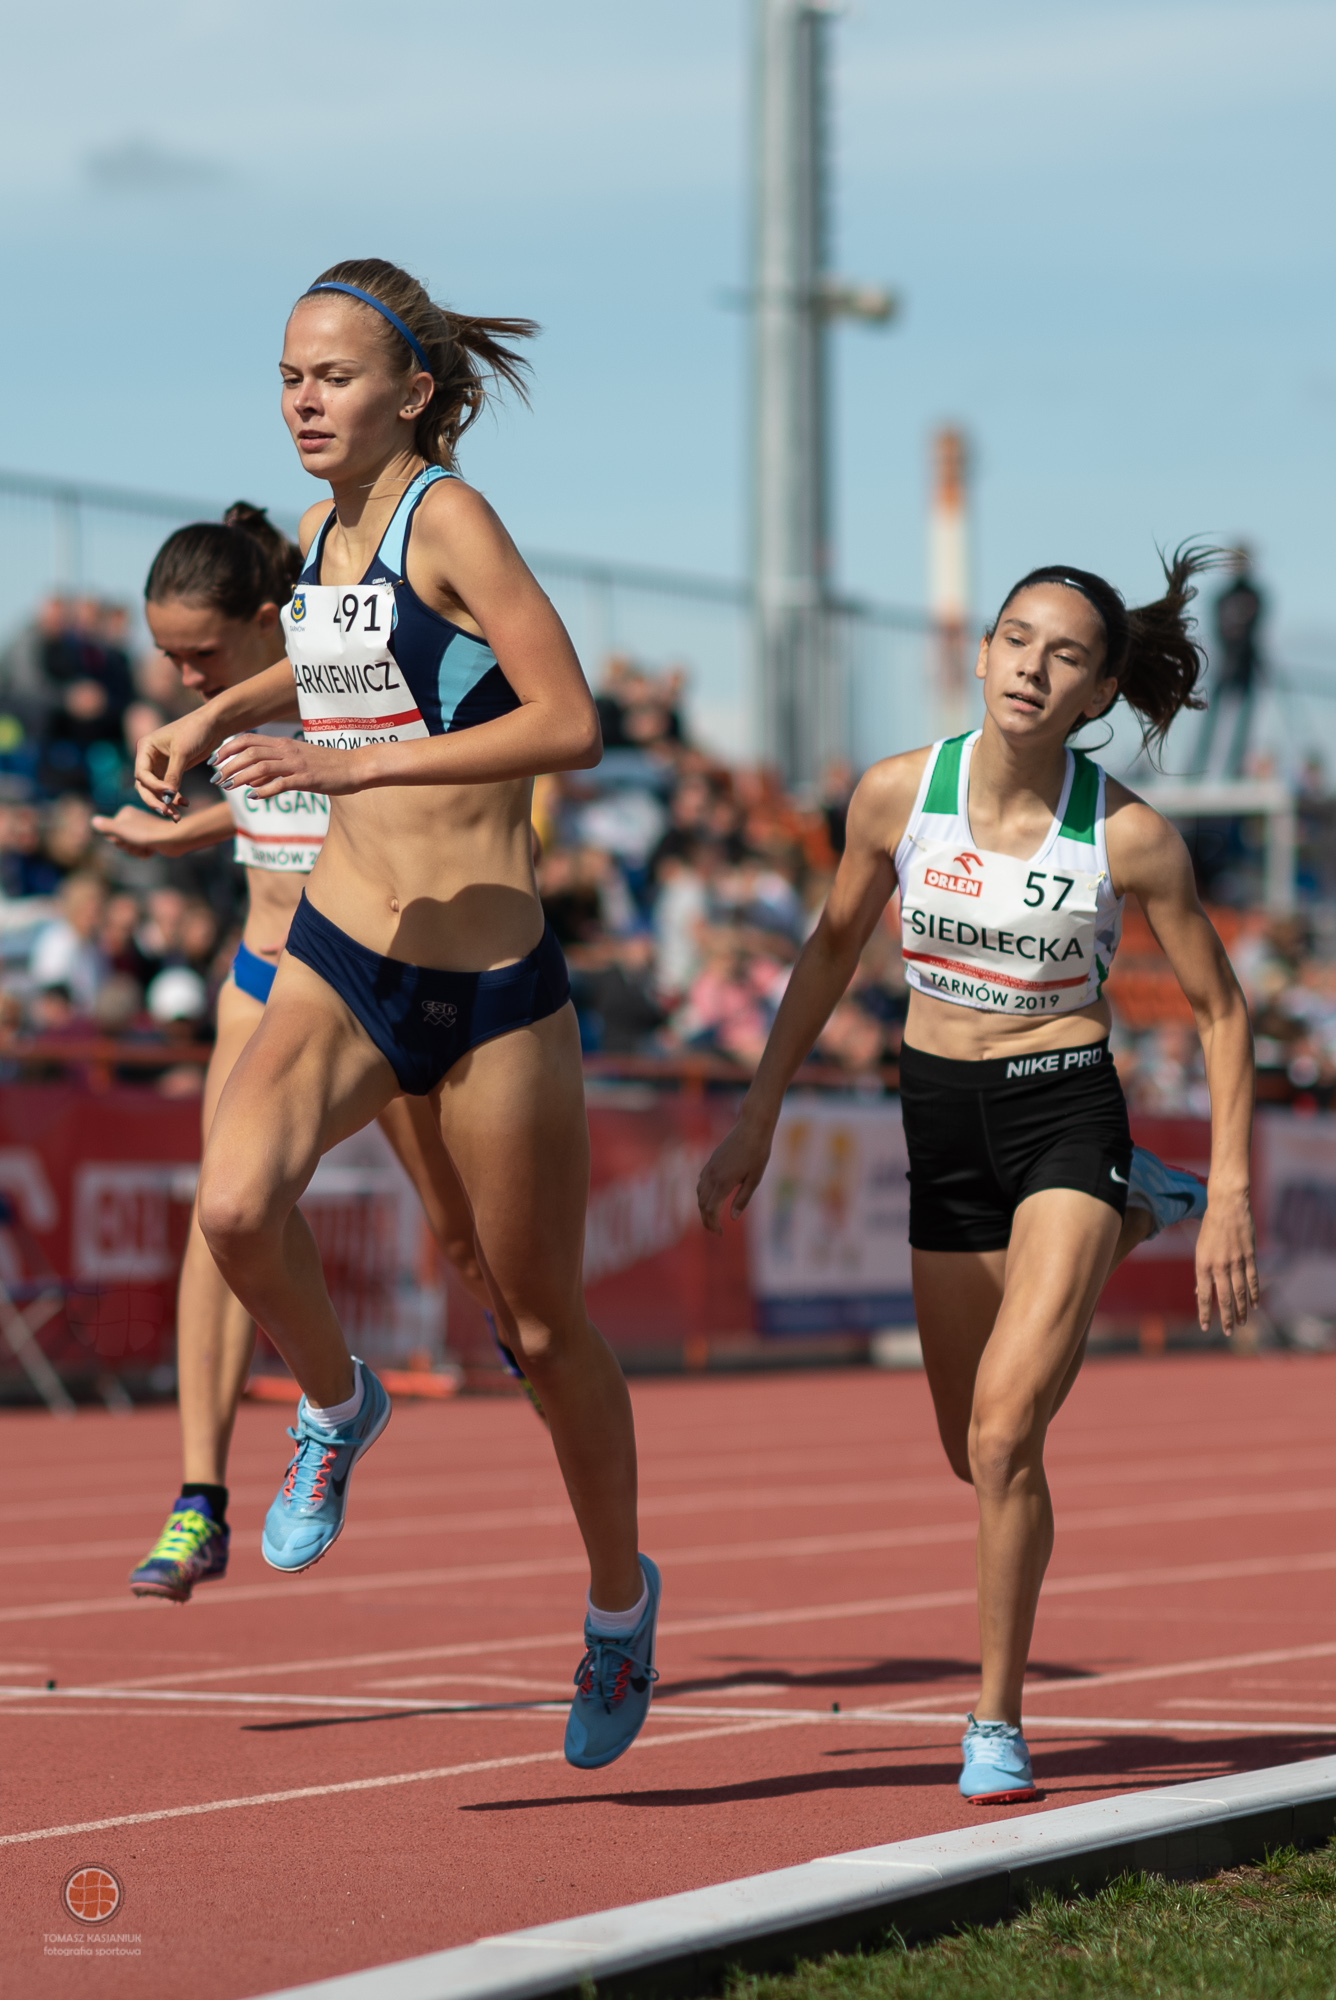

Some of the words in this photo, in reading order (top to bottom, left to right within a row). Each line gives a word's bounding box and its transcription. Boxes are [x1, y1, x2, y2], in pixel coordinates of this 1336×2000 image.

[333, 593, 381, 632] 491
[291, 661, 400, 694] ARKIEWICZ
[305, 733, 362, 751] RNÓW
[926, 871, 980, 896] ORLEN
[1023, 871, 1075, 911] 57
[911, 909, 1084, 962] SIEDLECKA
[930, 972, 1009, 1006] TARNÓW
[1014, 994, 1060, 1010] 2019
[1006, 1054, 1060, 1078] NIKE
[1063, 1047, 1102, 1070] PRO
